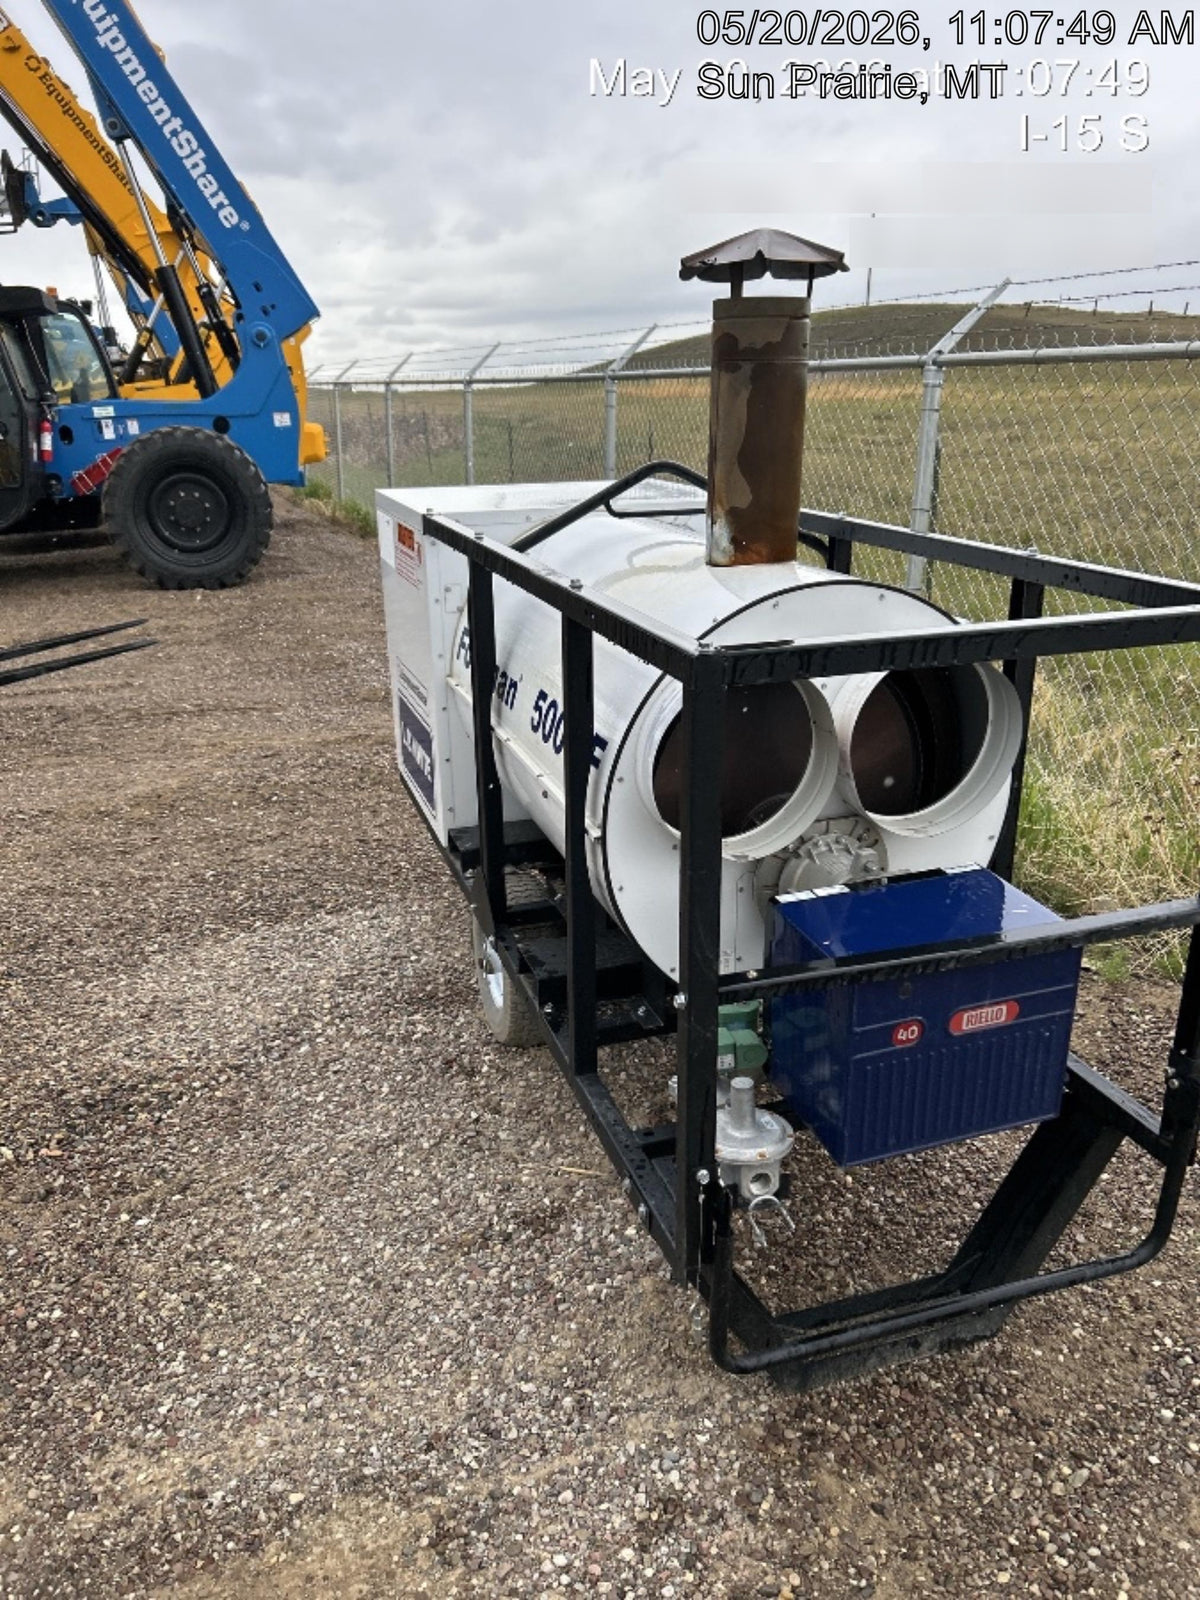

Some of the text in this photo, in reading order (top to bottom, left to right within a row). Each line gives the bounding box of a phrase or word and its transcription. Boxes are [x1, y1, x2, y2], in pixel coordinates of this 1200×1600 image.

[72, 0, 239, 229] uipmentShare
[456, 626, 519, 711] Foan
[531, 688, 609, 770] 500F
[897, 1025, 919, 1041] 40
[964, 1006, 1005, 1029] RIELLO
